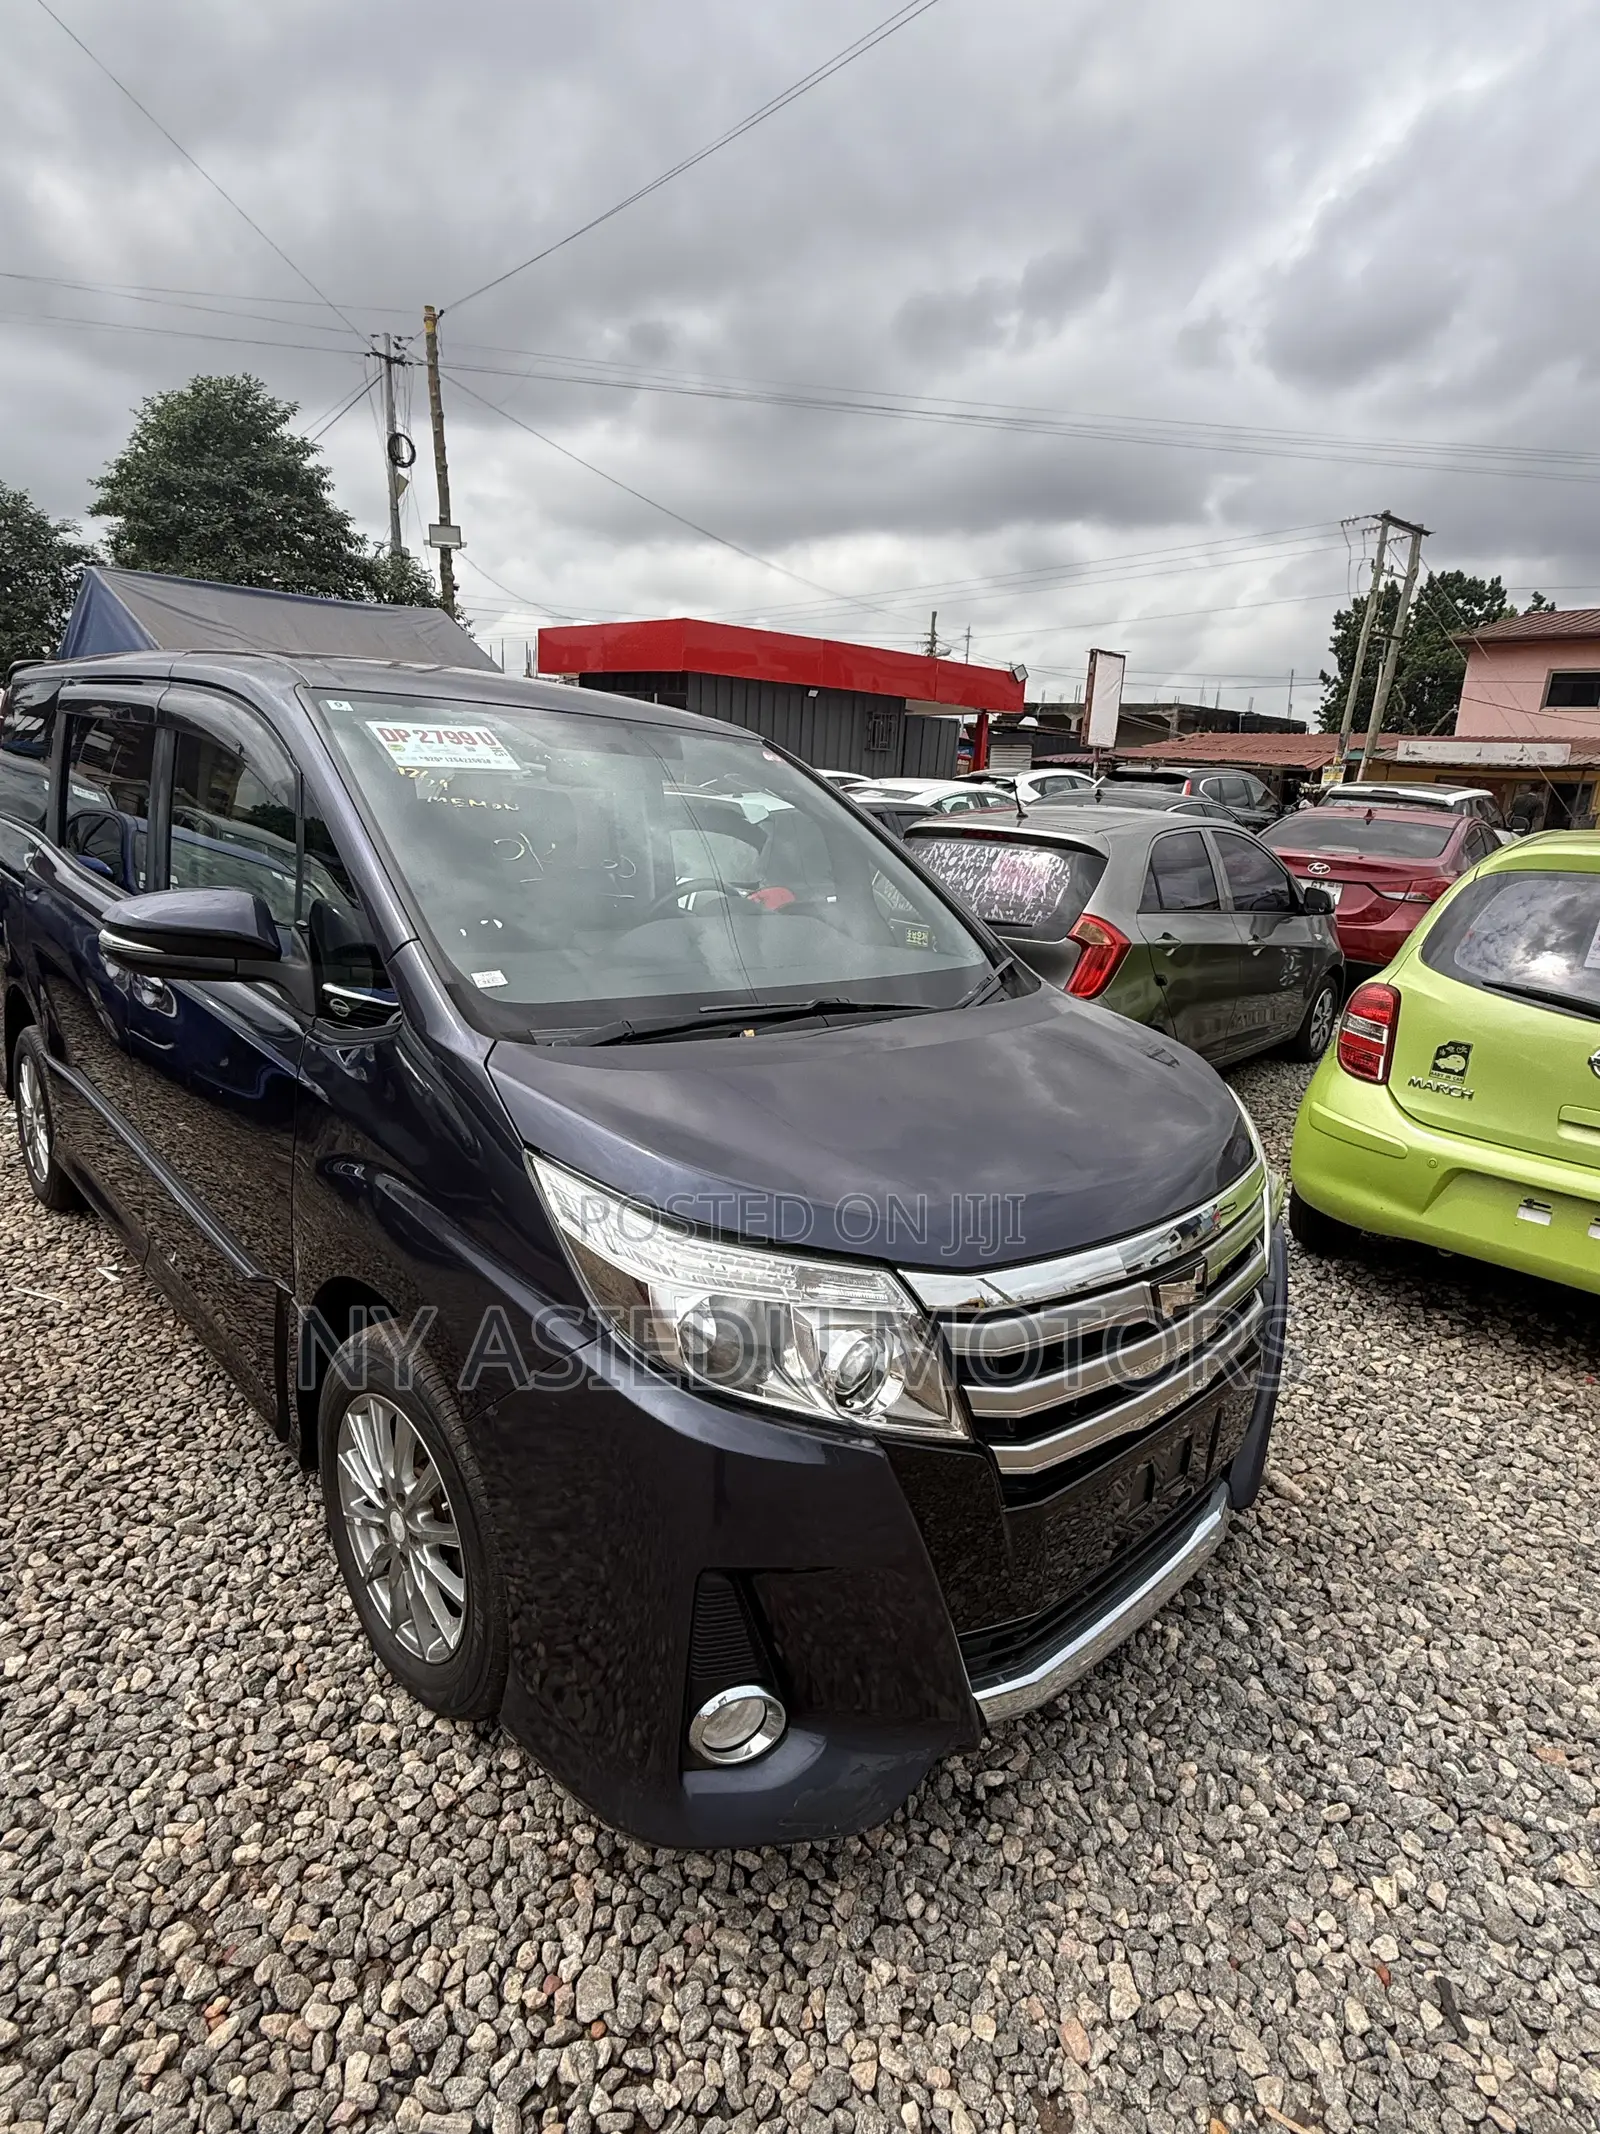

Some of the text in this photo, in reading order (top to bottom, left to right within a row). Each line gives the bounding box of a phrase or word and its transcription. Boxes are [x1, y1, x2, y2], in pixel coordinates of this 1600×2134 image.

[376, 727, 498, 747] DP 2799 U
[1407, 1075, 1475, 1101] MARCH
